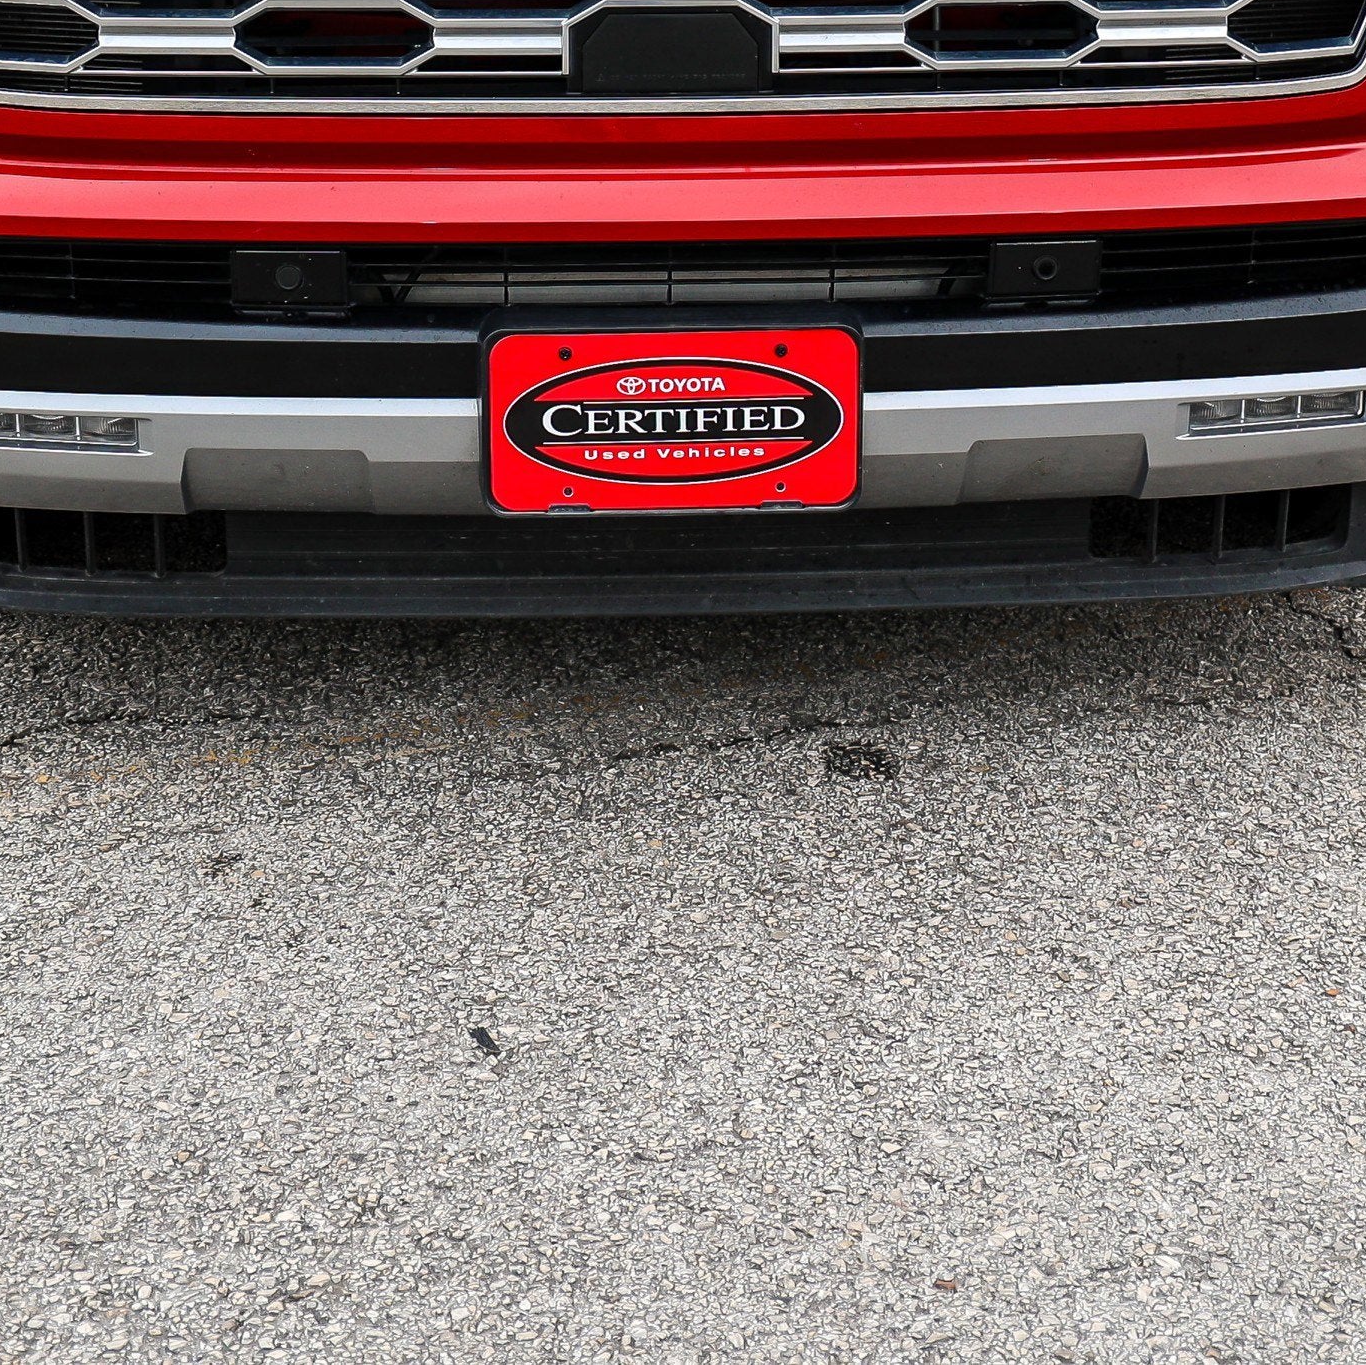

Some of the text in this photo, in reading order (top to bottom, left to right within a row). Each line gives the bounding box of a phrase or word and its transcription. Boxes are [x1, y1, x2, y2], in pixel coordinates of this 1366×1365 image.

[647, 377, 726, 393] TOYOTA
[541, 404, 806, 437] CERTIFIED
[584, 446, 766, 461] Used Vehicles
